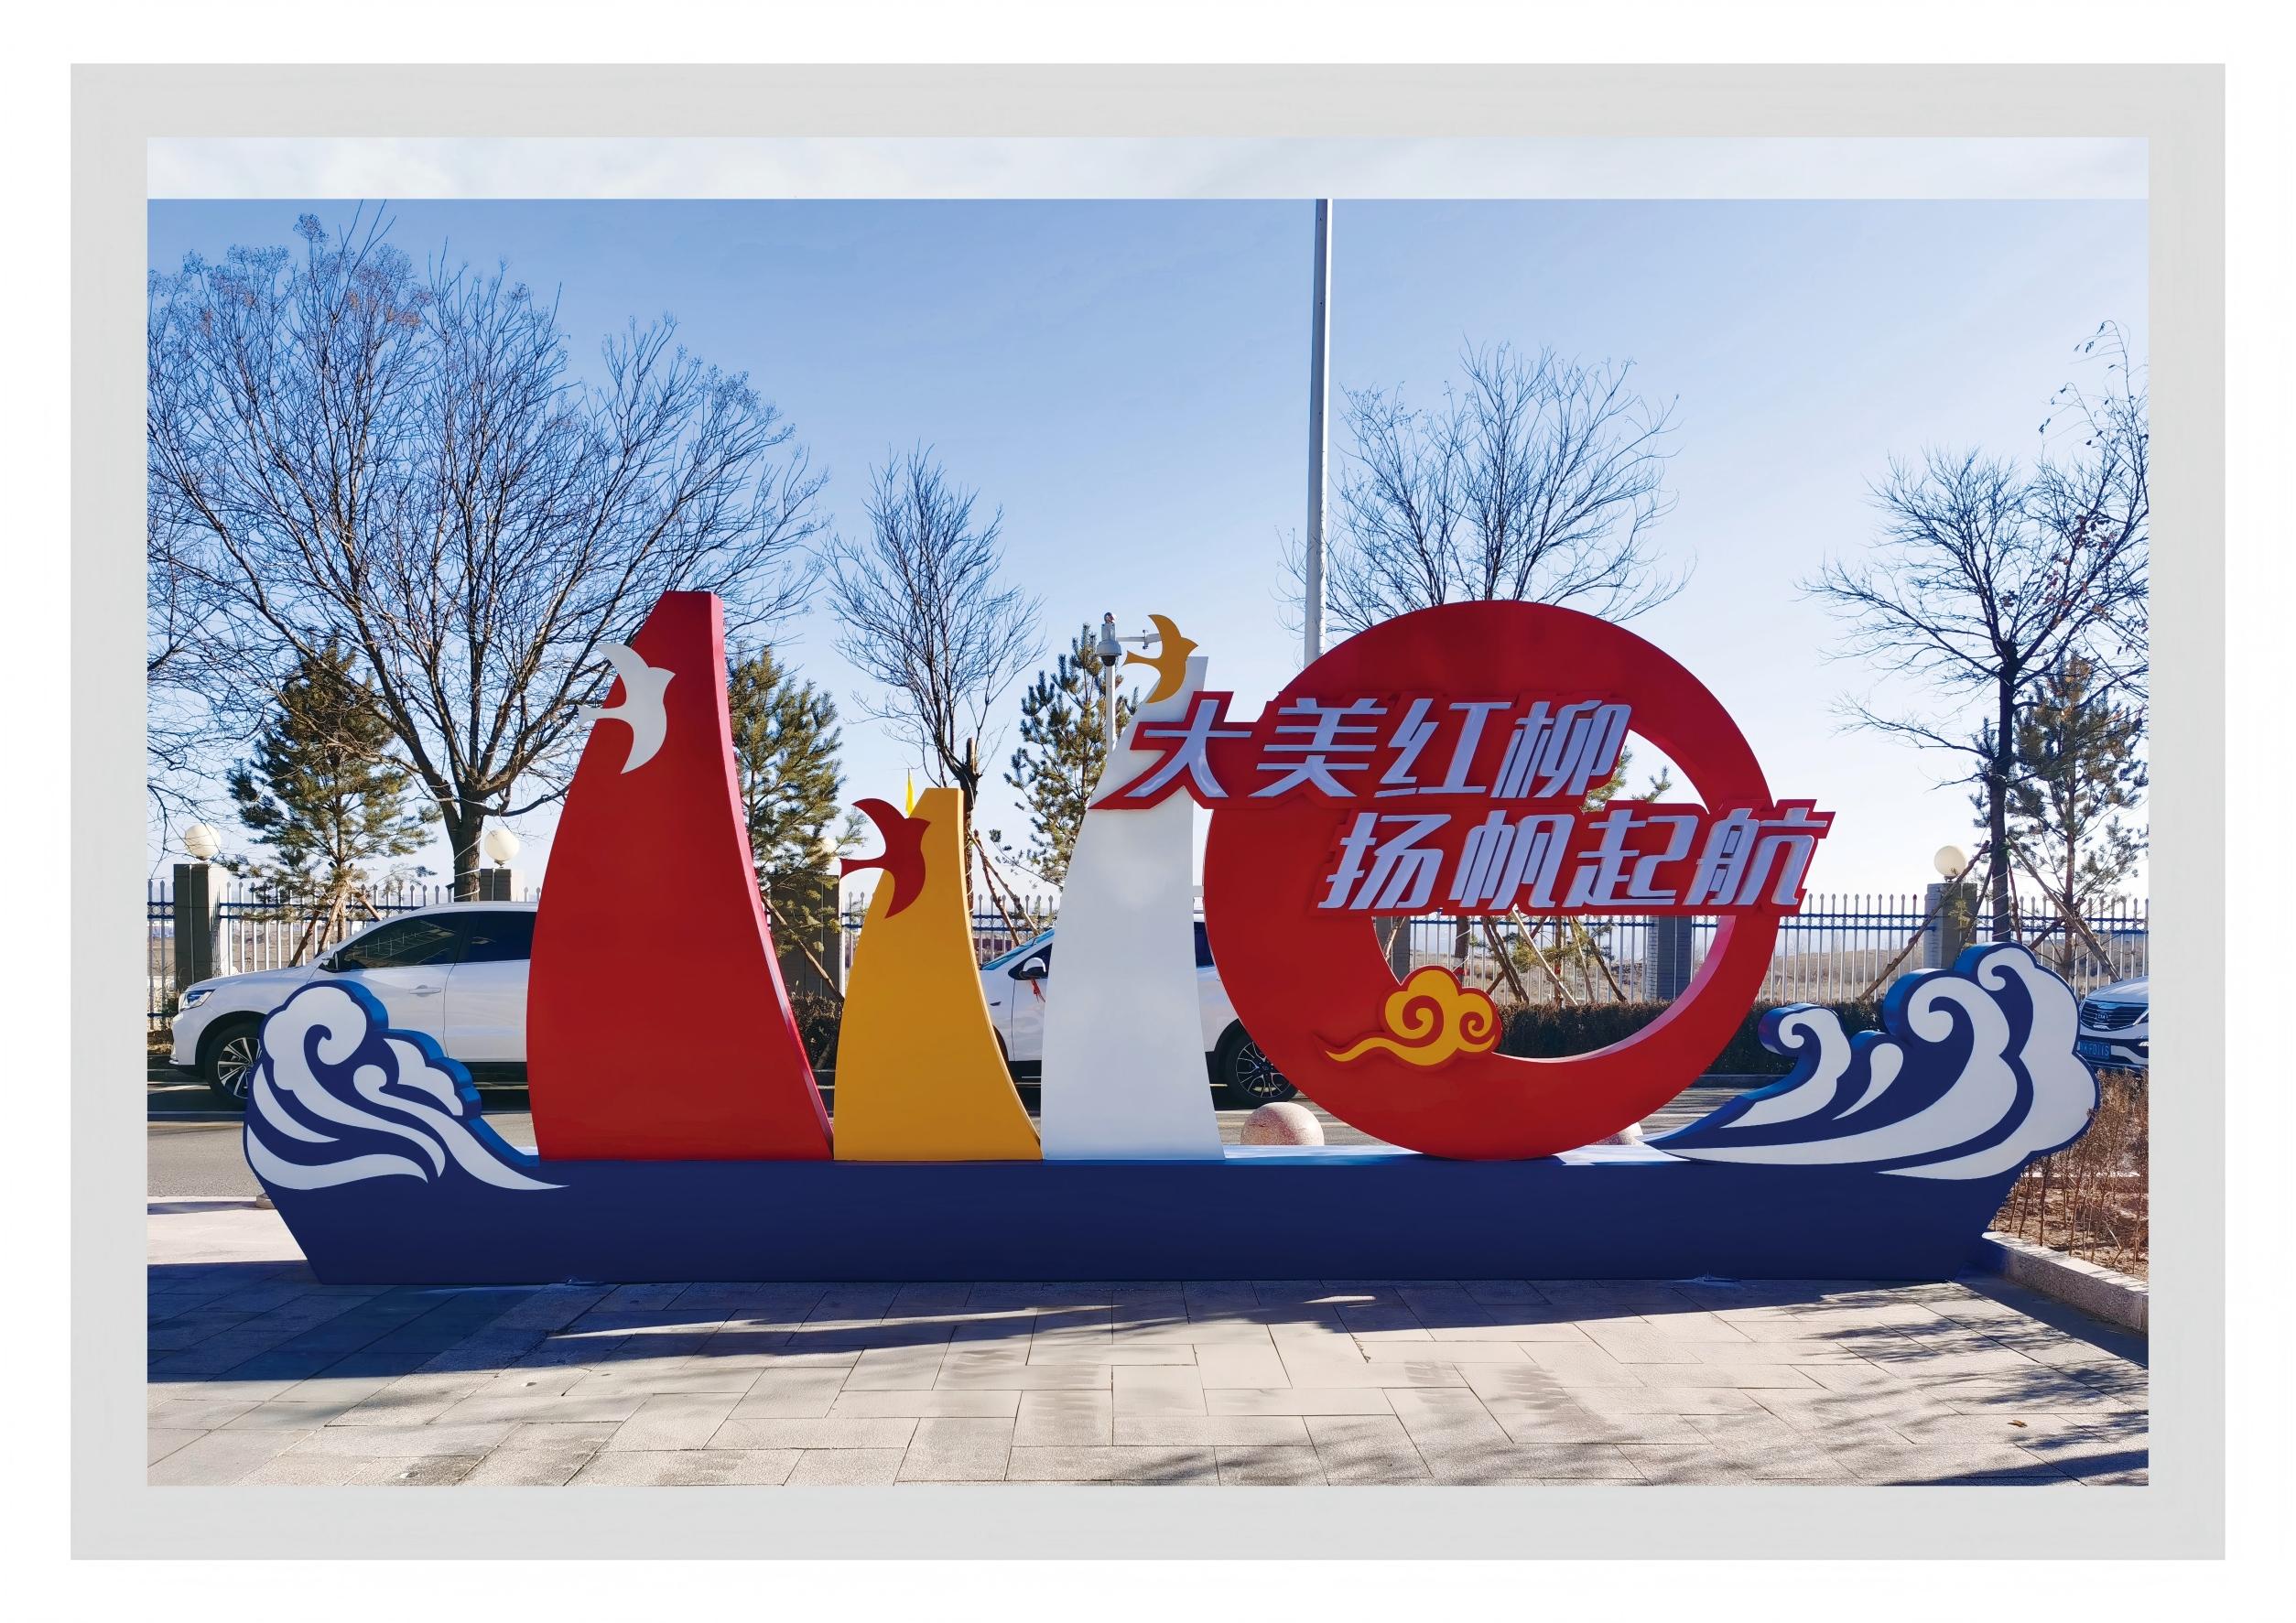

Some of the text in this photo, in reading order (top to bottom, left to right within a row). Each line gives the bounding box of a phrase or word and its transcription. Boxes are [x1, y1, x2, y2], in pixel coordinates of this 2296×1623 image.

[1126, 698, 1632, 799] 大美红柳
[1317, 807, 1827, 910] 扬帆起航
